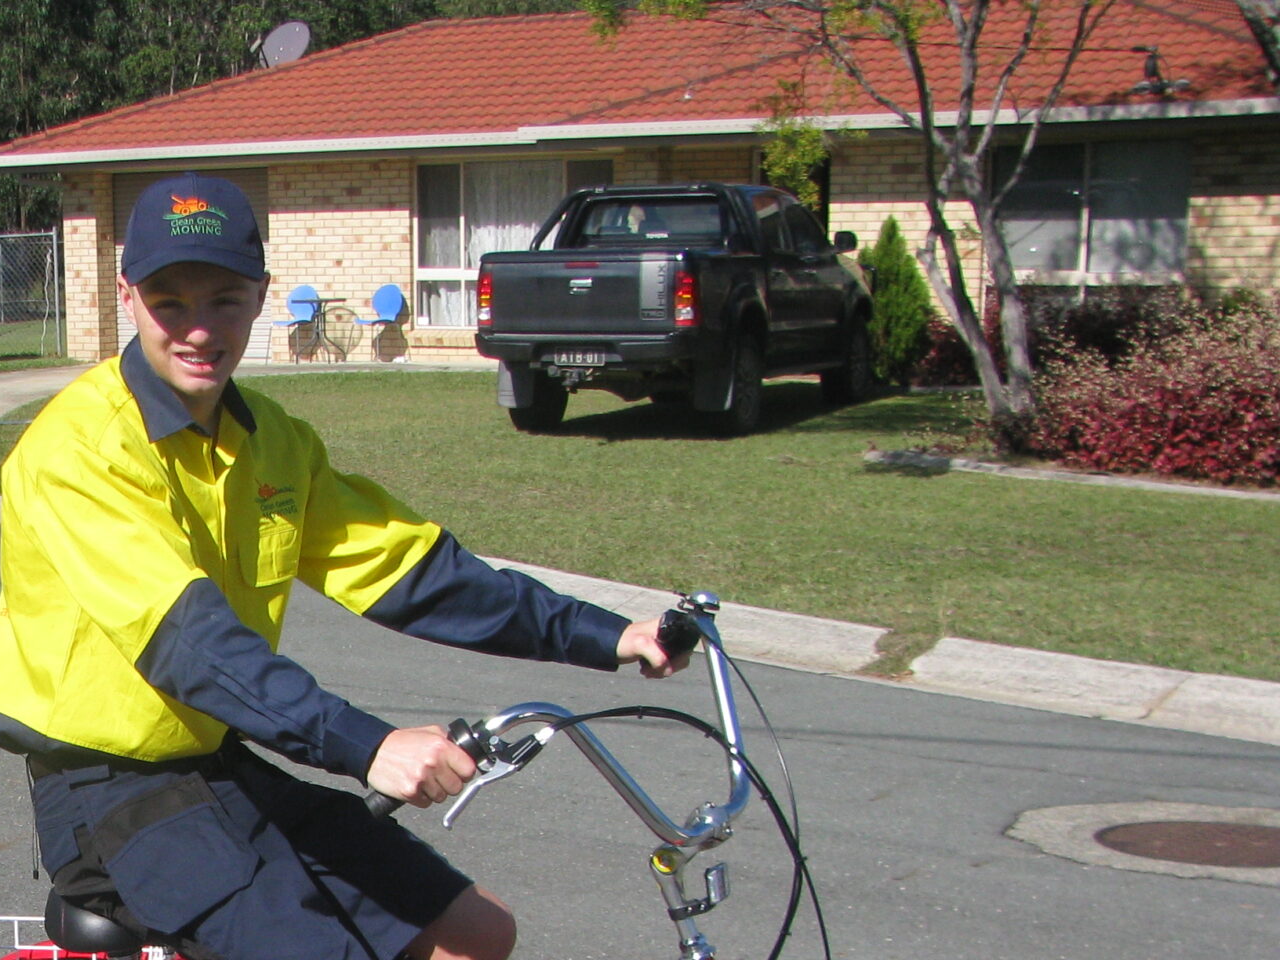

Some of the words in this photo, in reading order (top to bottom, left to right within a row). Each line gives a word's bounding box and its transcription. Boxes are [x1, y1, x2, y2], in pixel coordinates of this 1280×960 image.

[171, 218, 194, 227] Clean
[197, 216, 221, 226] Green
[171, 225, 222, 236] MOWING
[656, 263, 666, 307] HILUX
